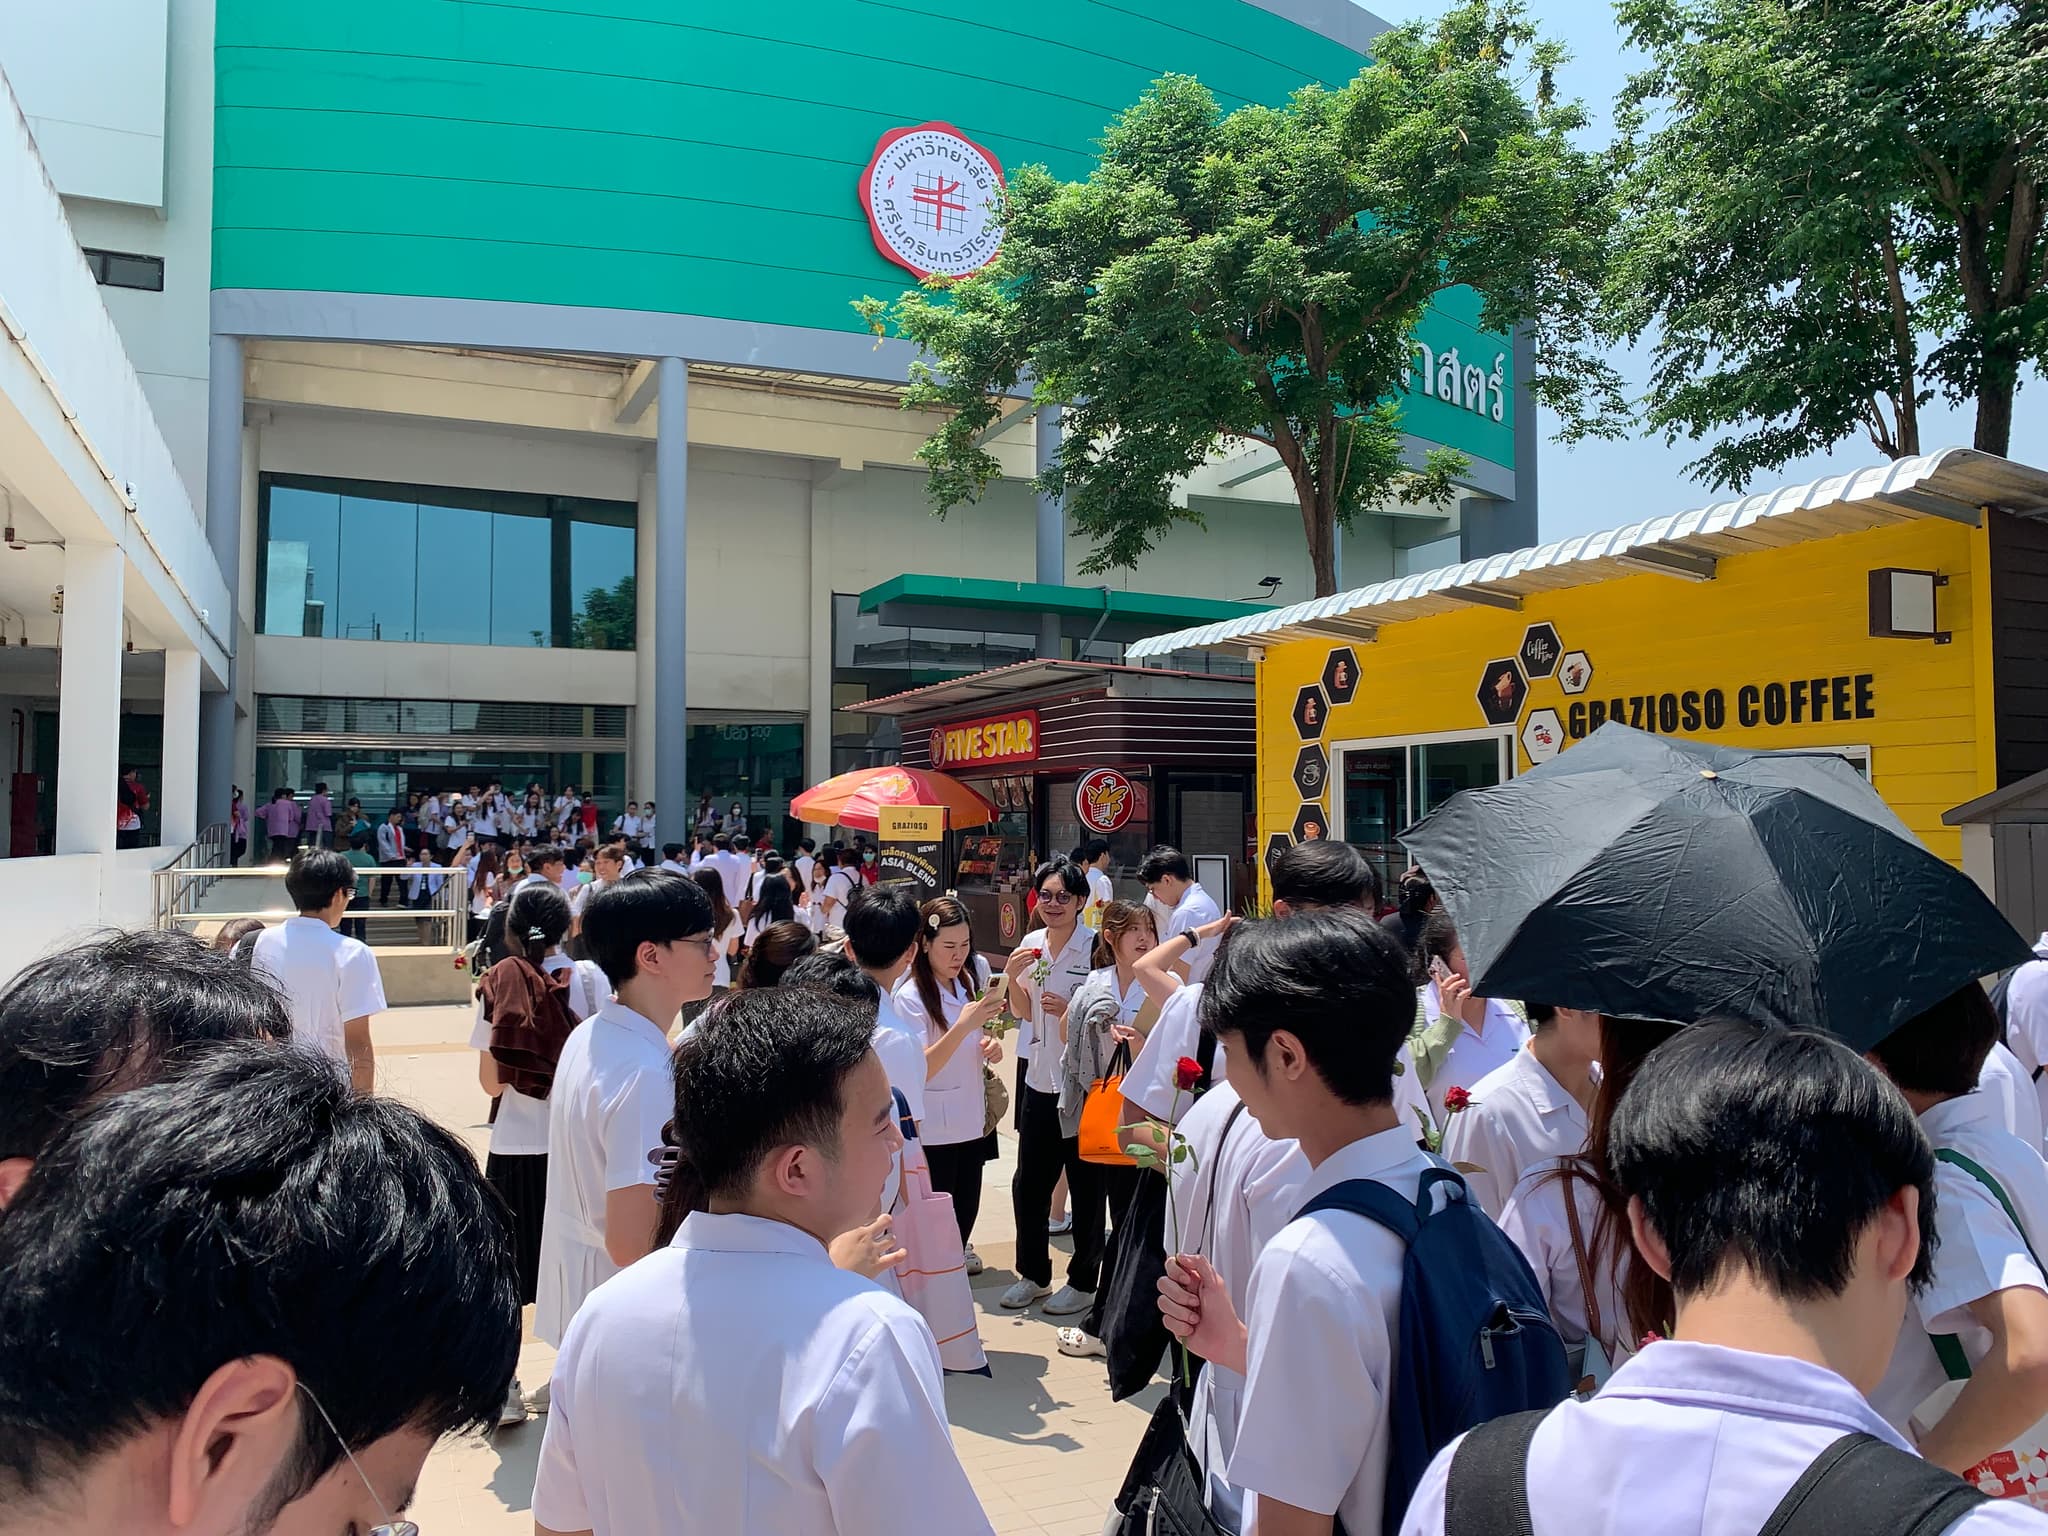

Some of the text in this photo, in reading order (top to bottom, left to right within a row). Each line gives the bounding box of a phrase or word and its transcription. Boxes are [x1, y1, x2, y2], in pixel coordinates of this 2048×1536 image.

[893, 141, 988, 190] มหาวิทยาลัย
[1568, 673, 1875, 739] GRAZIOSO COFFEE
[945, 718, 1033, 761] FIVE STAR
[891, 822, 928, 831] GRAZIOSO
[880, 857, 905, 869] ASIA
[905, 863, 937, 888] BLEND
